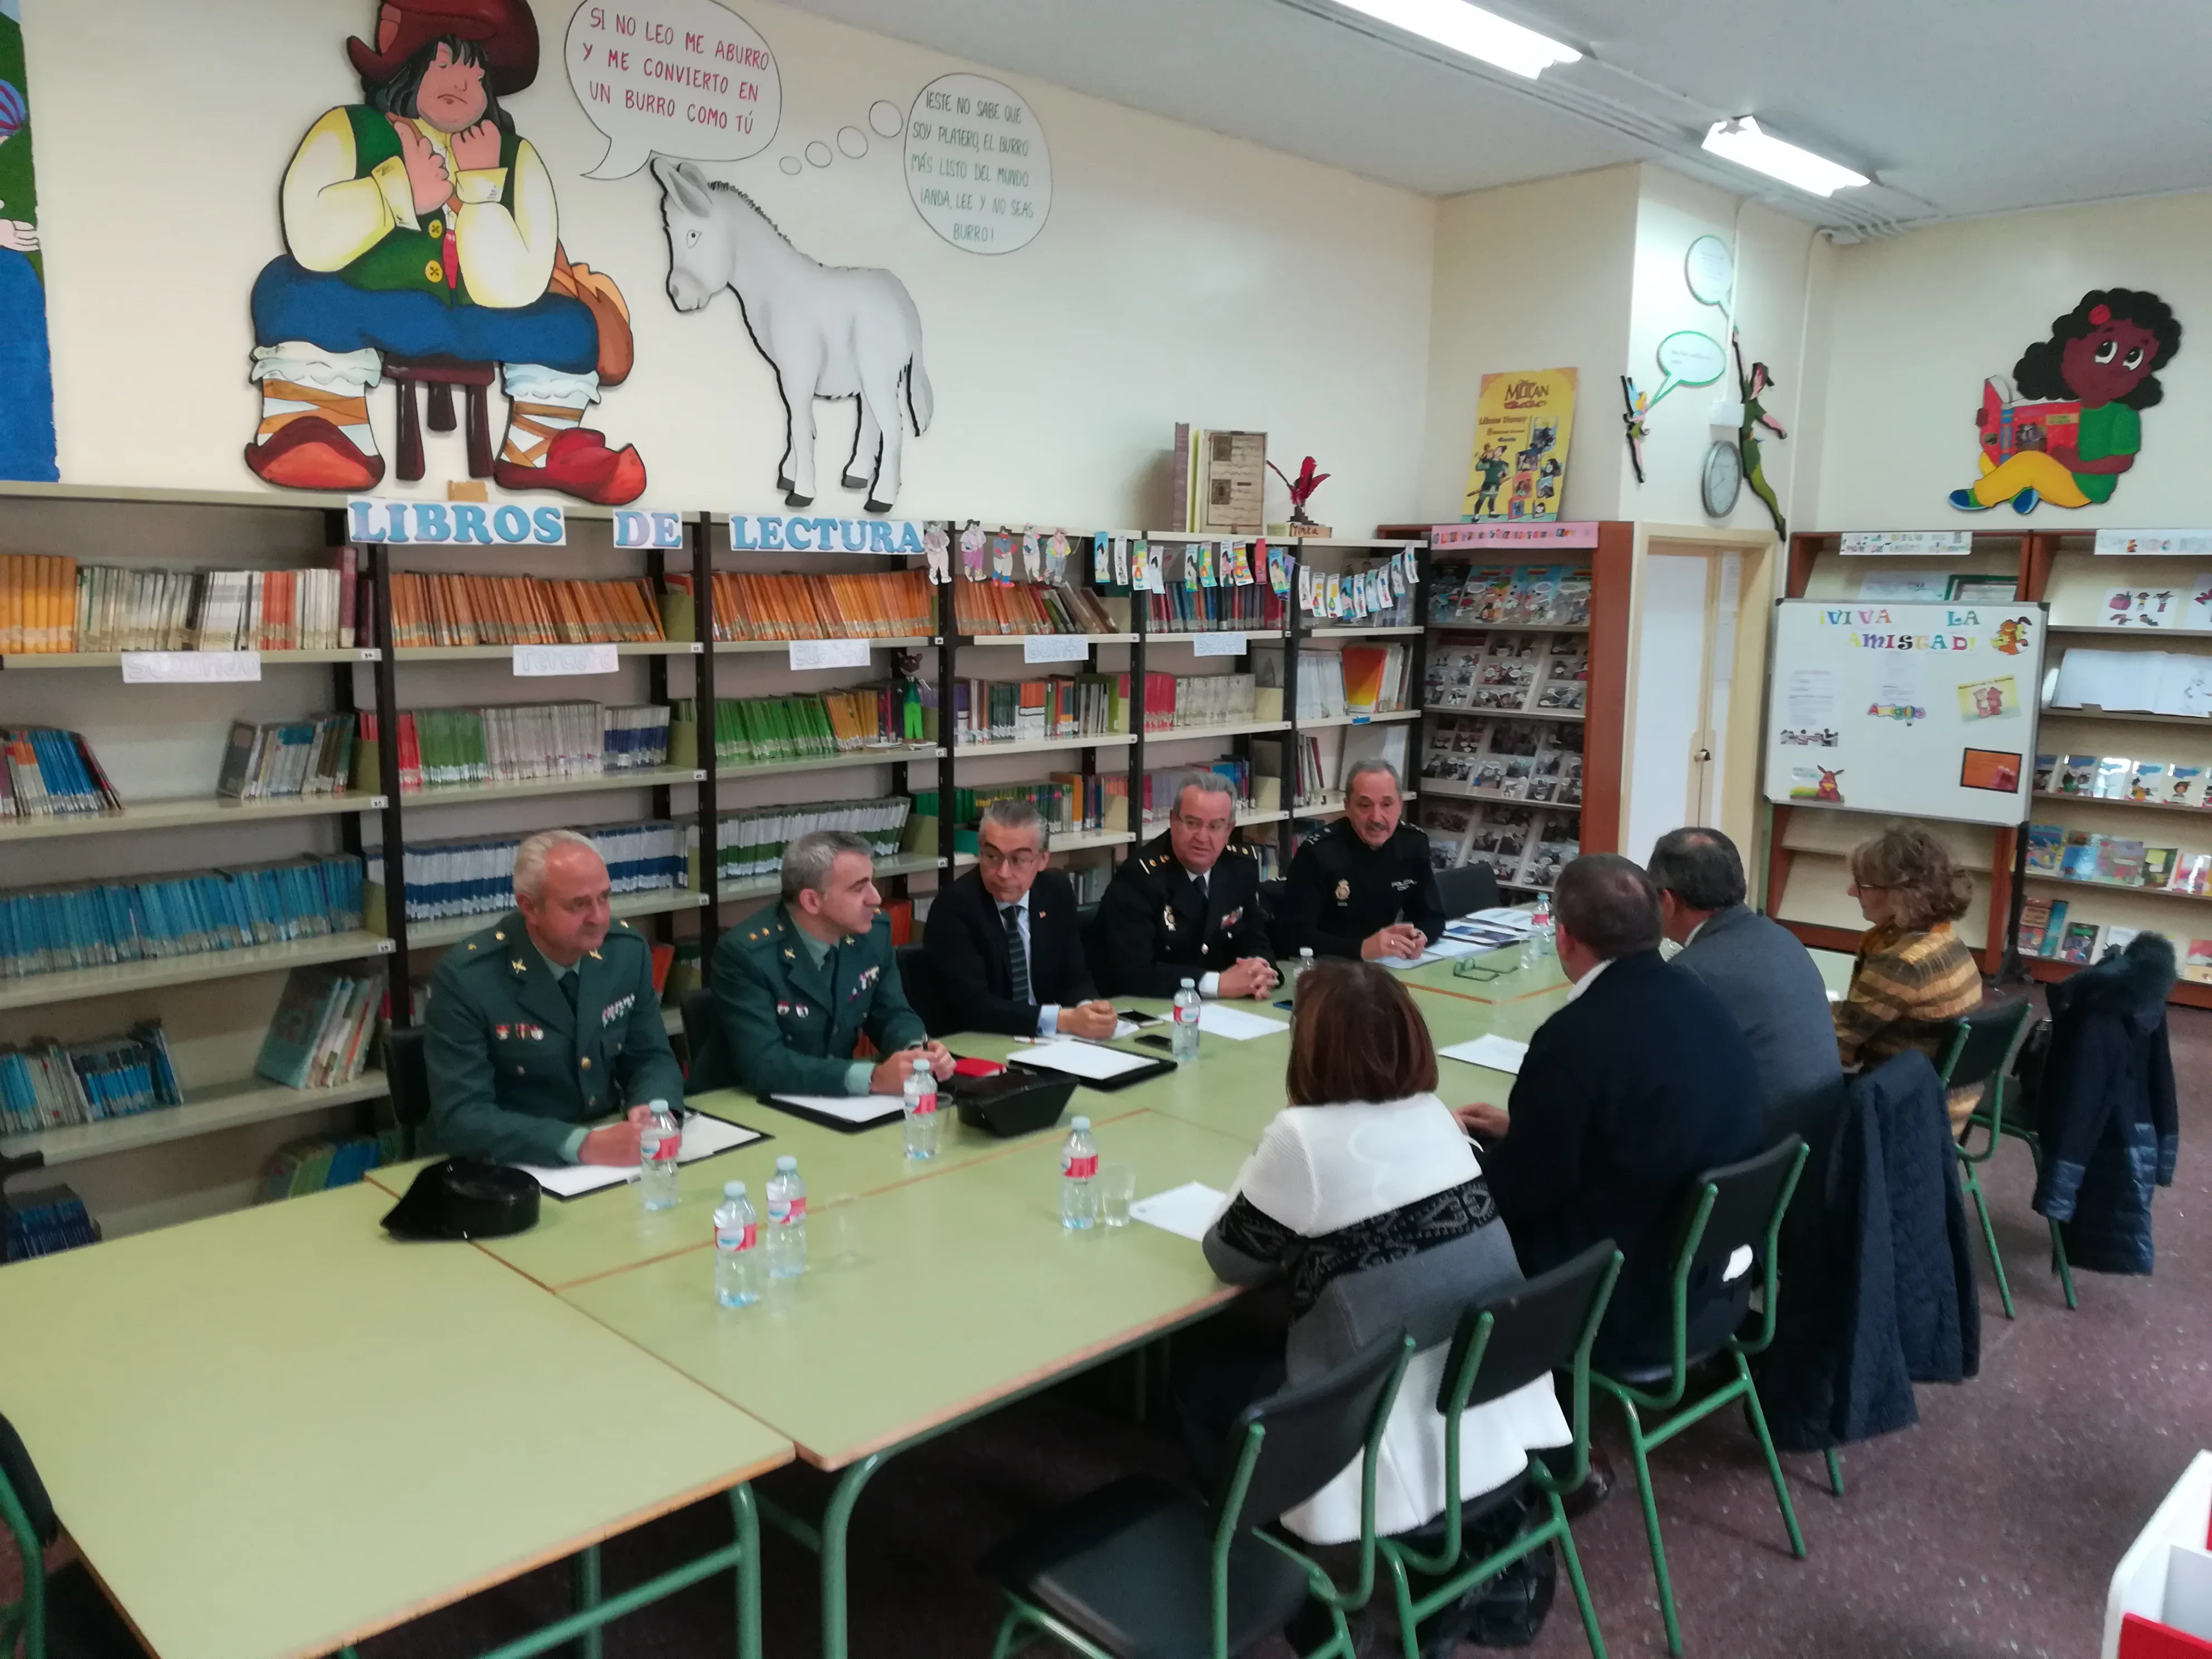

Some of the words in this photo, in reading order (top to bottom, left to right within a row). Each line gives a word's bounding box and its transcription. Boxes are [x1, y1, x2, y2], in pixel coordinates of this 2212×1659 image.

[590, 8, 605, 30] SI
[617, 14, 636, 36] NO
[646, 21, 673, 45] LEO
[686, 32, 705, 54] ME
[715, 41, 769, 71] ABURRO
[583, 42, 593, 61] Y
[608, 49, 629, 71] ME
[644, 58, 728, 94] CONVIERTO
[739, 81, 758, 102] EN
[590, 81, 610, 104] UN
[625, 89, 675, 117] BURRO
[687, 104, 727, 129] COMO
[735, 111, 753, 134] TÚ
[957, 97, 970, 114] NO
[977, 100, 1000, 119] SABE
[1005, 105, 1021, 124] QUE
[913, 122, 932, 140] SOY
[983, 134, 994, 151] EL
[999, 136, 1029, 156] BURRO
[911, 152, 932, 173] MÁS
[939, 158, 967, 179] LISTO
[974, 163, 991, 182] DEL
[997, 168, 1029, 187] MUNDO
[955, 192, 973, 211] LEE
[979, 195, 986, 211] Y
[992, 198, 1006, 215] NO
[1011, 200, 1034, 219] SEAS
[350, 502, 564, 544] LIBROS
[615, 512, 682, 547] DE
[732, 516, 925, 554] LECTURA
[1947, 610, 1980, 626] LA
